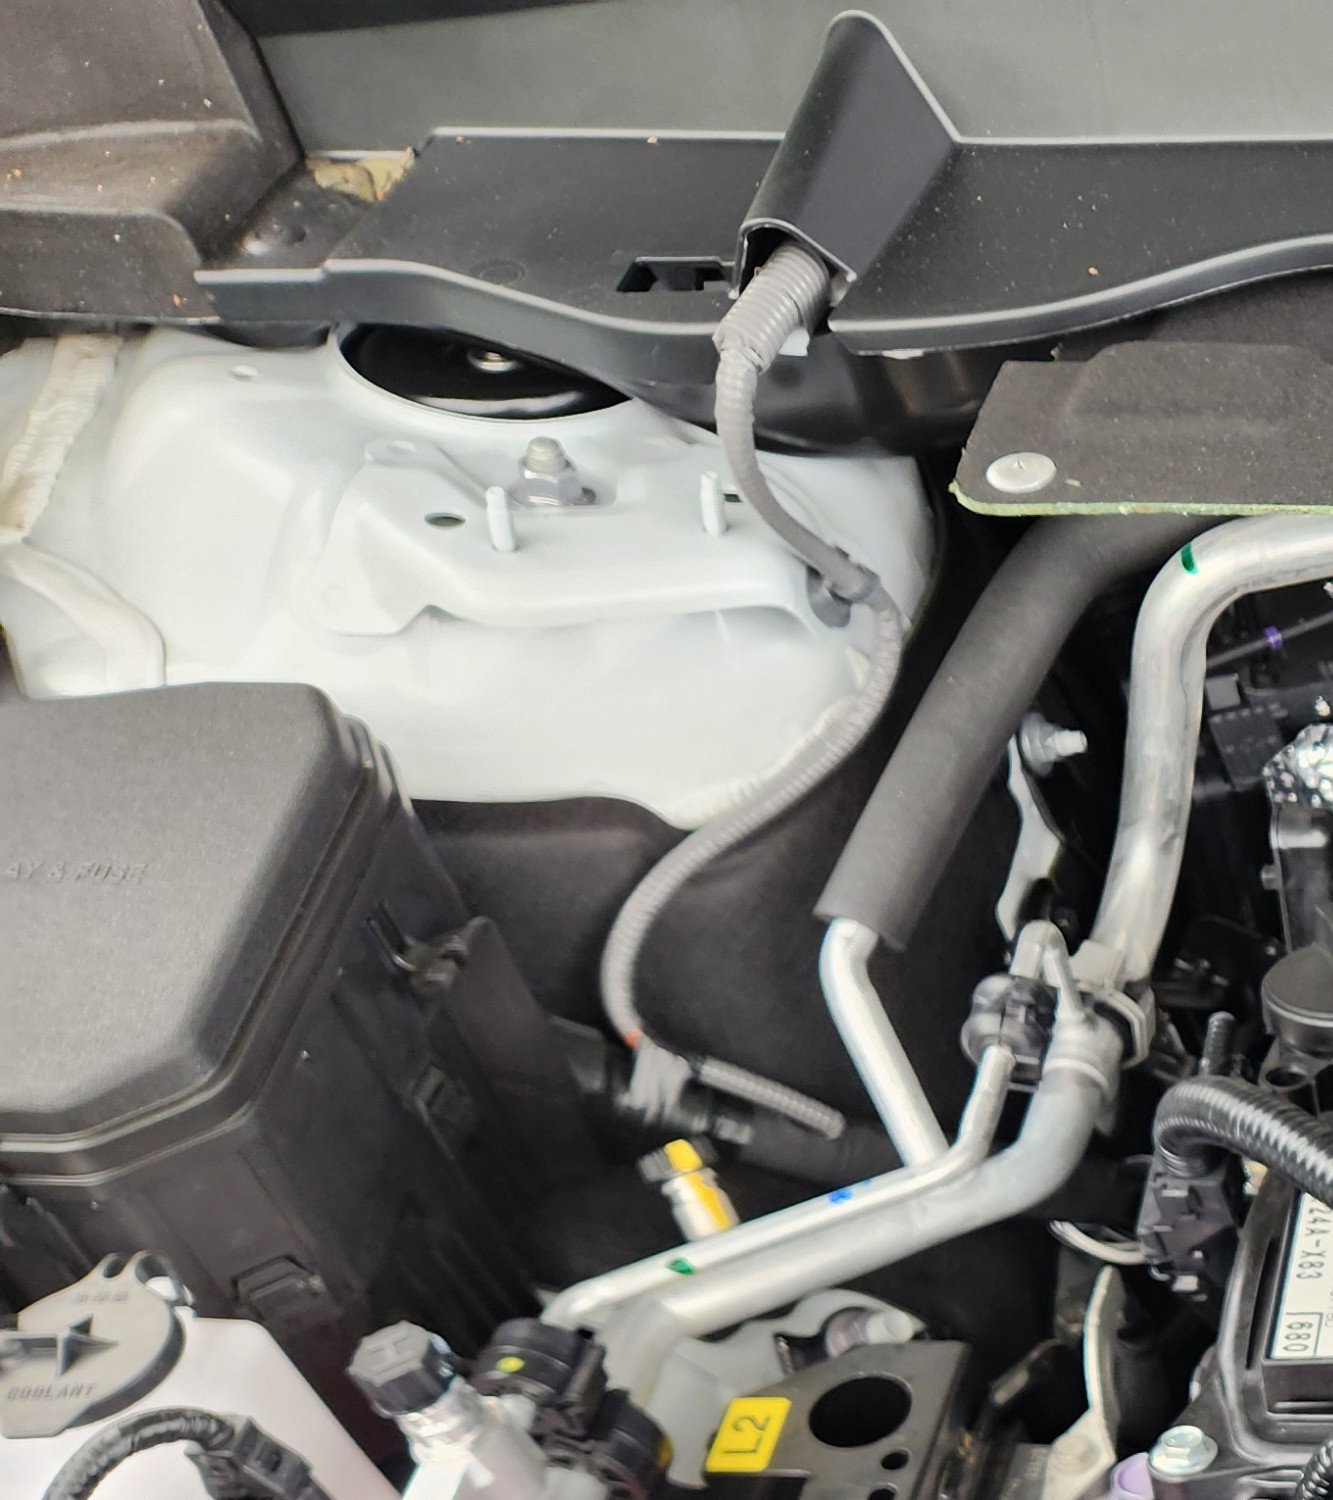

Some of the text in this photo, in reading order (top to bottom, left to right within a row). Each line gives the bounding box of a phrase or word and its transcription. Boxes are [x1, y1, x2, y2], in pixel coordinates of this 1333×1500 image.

[1295, 1203, 1333, 1281] 24A-X83
[1282, 1321, 1314, 1352] 680
[6, 1381, 98, 1402] COOLANT
[722, 1413, 772, 1455] L2
